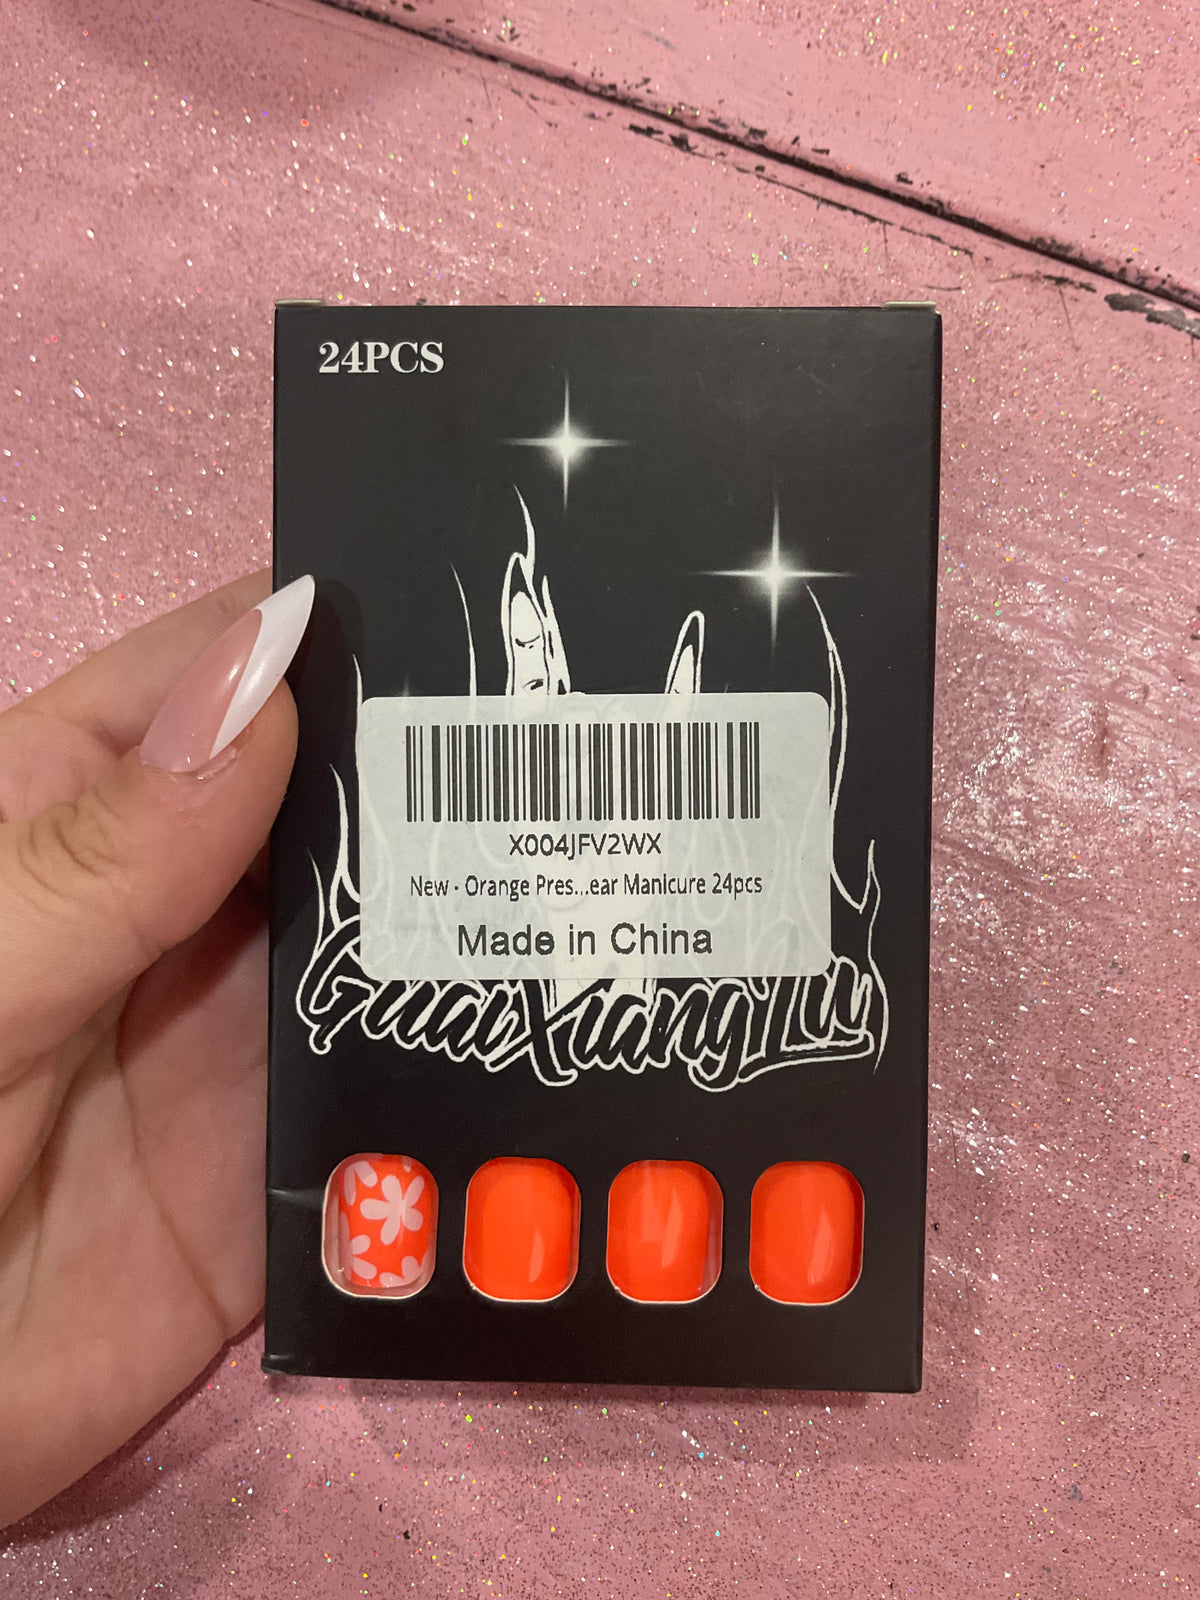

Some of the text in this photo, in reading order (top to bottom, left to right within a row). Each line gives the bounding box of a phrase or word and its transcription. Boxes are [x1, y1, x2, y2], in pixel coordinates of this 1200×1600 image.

[318, 341, 445, 374] 24PCS
[508, 831, 662, 861] X004JFV2WX
[410, 875, 450, 897] New
[464, 874, 530, 902] Orange
[623, 873, 706, 896] Manicure
[711, 872, 763, 901] 24pcs
[457, 921, 713, 957] Made in China
